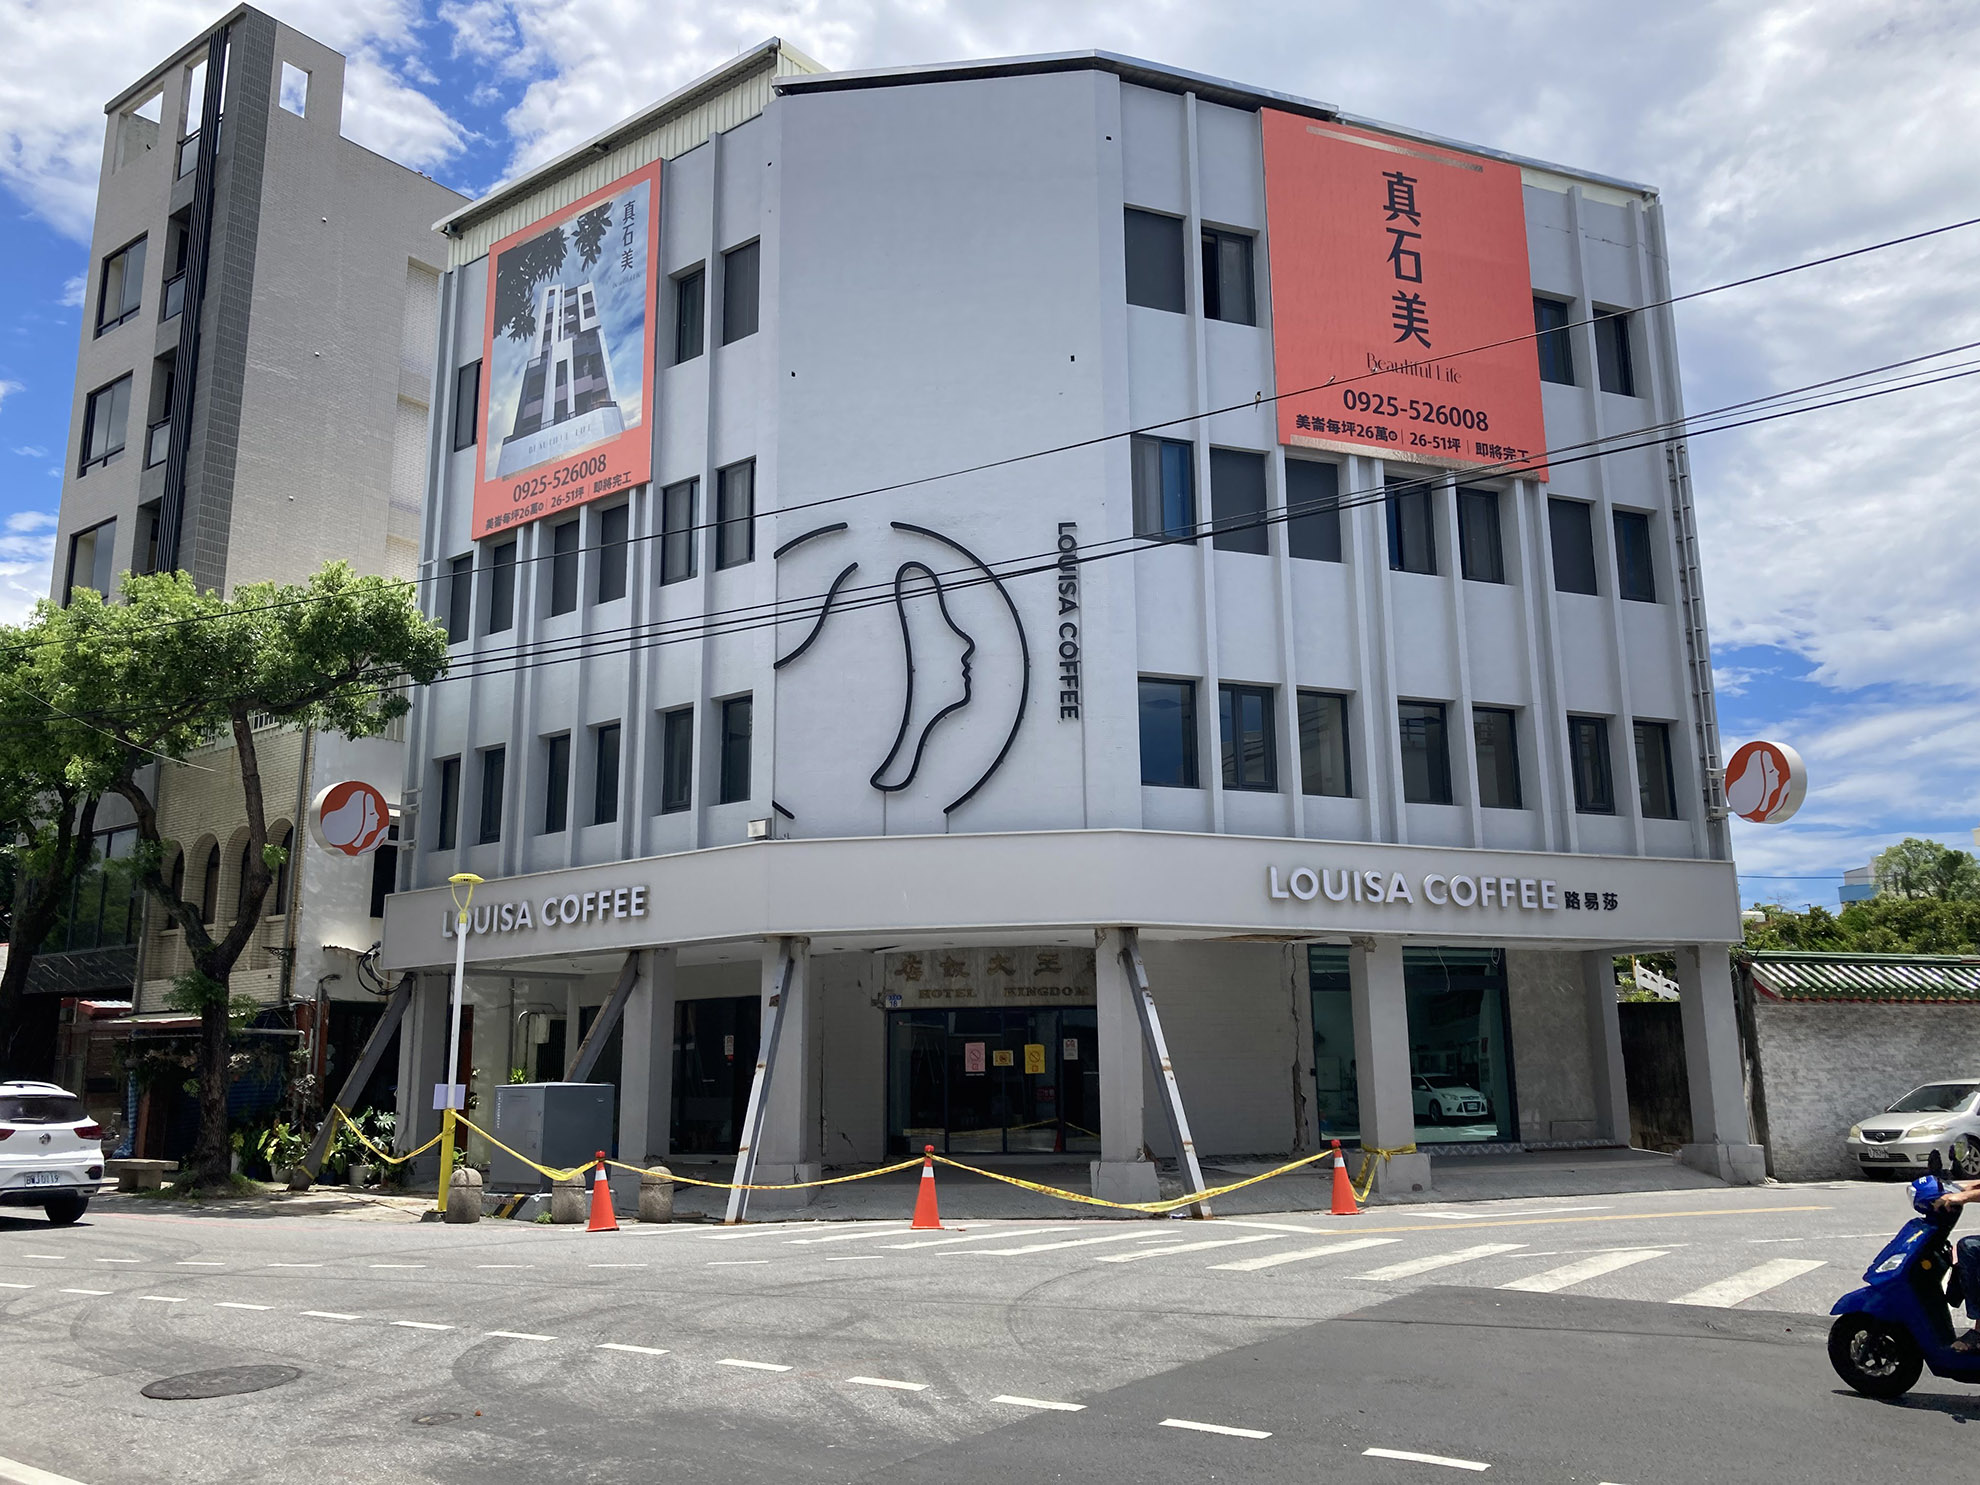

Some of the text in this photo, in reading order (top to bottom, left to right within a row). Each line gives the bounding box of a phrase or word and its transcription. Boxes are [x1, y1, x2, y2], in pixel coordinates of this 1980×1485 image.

[620, 200, 636, 273] 真石美
[1382, 171, 1432, 349] 真石美
[1367, 352, 1462, 385] Beautiful Life
[1343, 389, 1489, 432] 0925-526008
[1409, 432, 1461, 453] 26-51坪
[1475, 441, 1531, 464] 即將完工
[513, 453, 607, 503] 0925-526008
[593, 471, 632, 494] 即將完工
[1057, 521, 1080, 721] LOUISA COFFEE
[541, 886, 646, 927] COFFEE
[1267, 865, 1619, 911] LOUISA COFFEE 路易莎
[918, 986, 1089, 999] HOTEL KINGDOM
